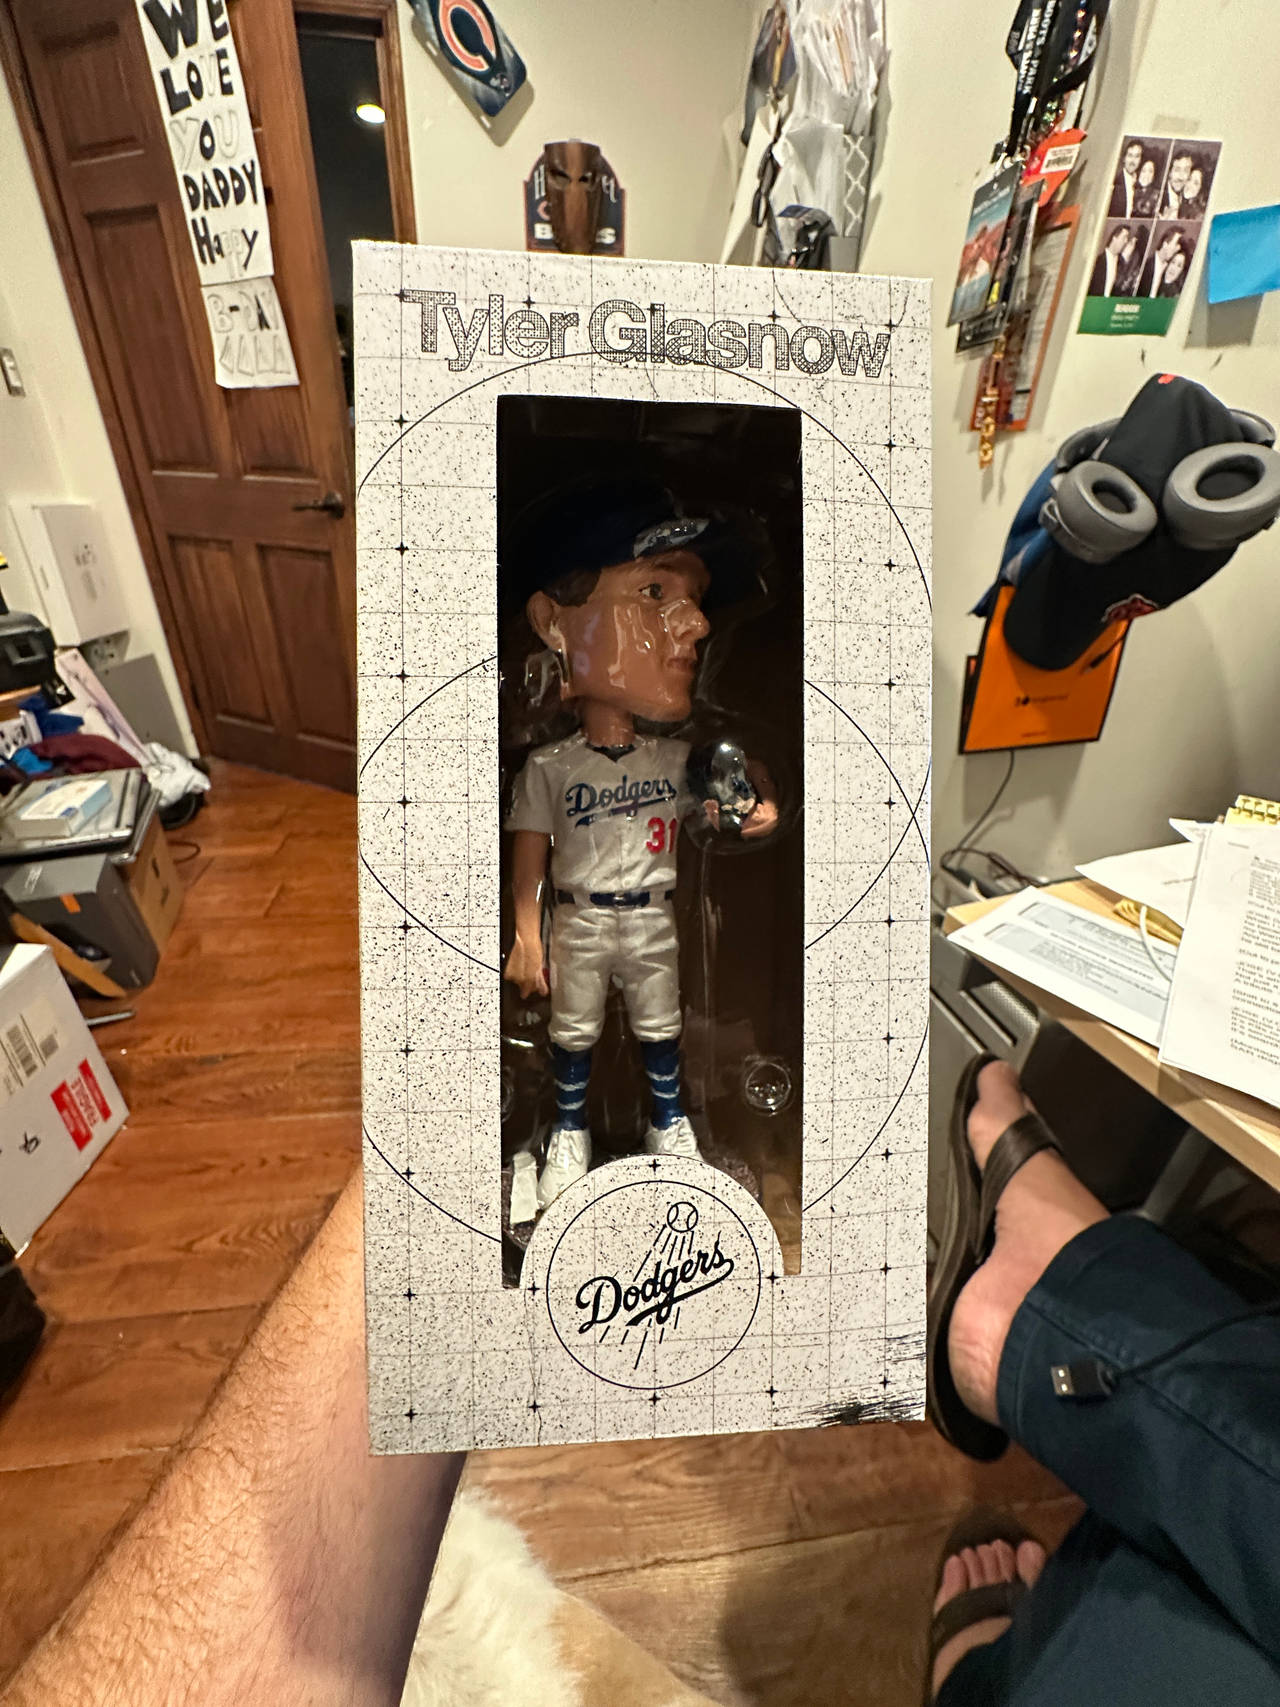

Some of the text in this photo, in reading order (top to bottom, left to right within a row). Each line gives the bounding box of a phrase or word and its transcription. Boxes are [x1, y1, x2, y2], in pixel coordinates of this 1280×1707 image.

[142, 0, 230, 60] WE
[159, 47, 235, 117] LOVE
[169, 109, 241, 171] YOU
[182, 159, 259, 212] DADDY
[401, 288, 892, 379] Tyler Glasnow
[564, 774, 678, 821] Dodgers
[645, 816, 678, 855] 31
[575, 1230, 735, 1335] Dodgers
